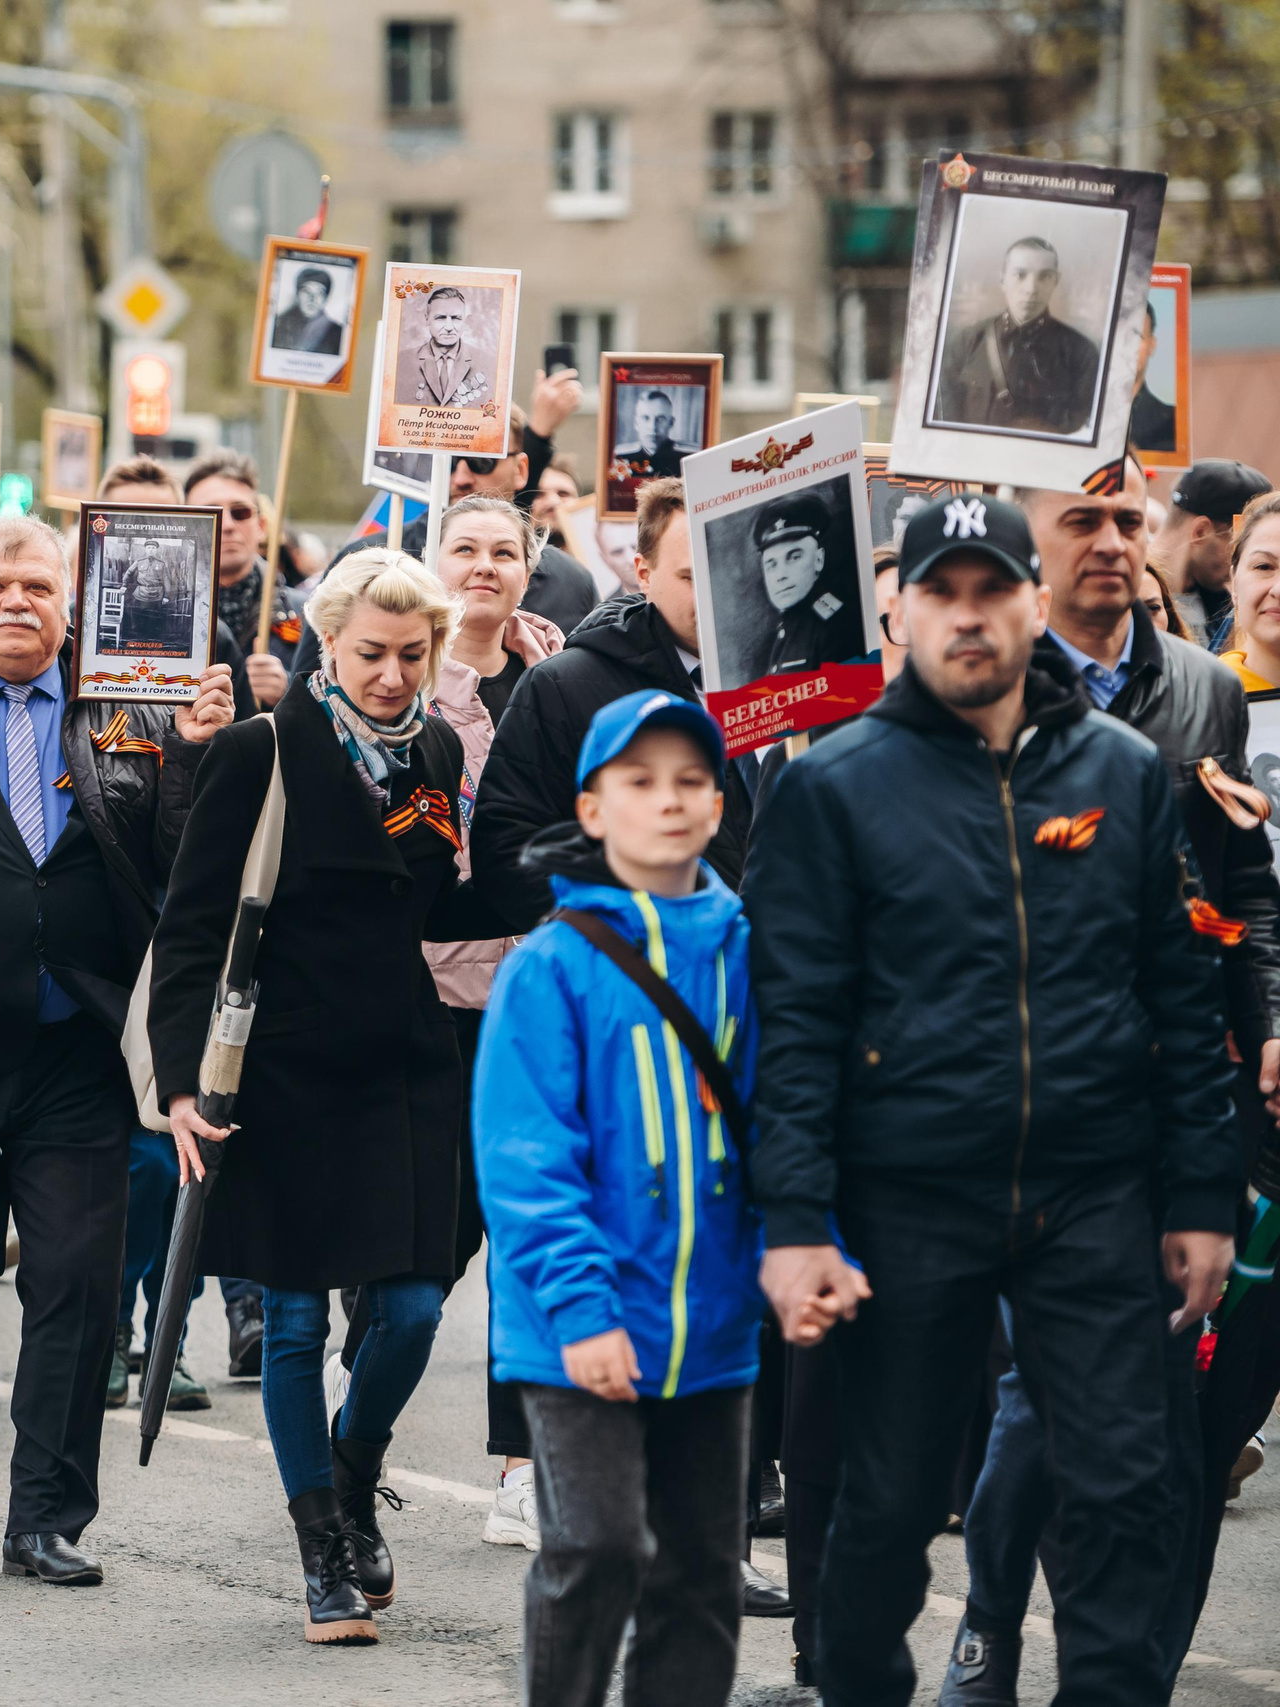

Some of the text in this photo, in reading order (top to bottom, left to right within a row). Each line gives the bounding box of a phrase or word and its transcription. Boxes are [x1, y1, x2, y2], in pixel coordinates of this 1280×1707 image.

[982, 170, 1116, 195] БЕССМЕРТНЫЙ ПОЛК
[419, 407, 461, 420] Рожко
[398, 418, 480, 432] Пётр Исидорович
[403, 430, 436, 438] 15.09.1915
[441, 433, 475, 441] 24.11.2008
[408, 439, 434, 447] Гвардии
[694, 449, 858, 514] БЕССМЕРТНЫЙ ПОЛК РОССИИ
[114, 522, 187, 533] БЕССМЕРТНЫЙ ПОЛК
[943, 498, 988, 539] NY
[101, 685, 140, 693] ПОМНЮ!
[149, 687, 192, 695] ГОРЖУСЬ!
[722, 676, 829, 728] БЕРЕСНЕВ
[725, 710, 785, 739] АЛЕКСАНДР
[726, 718, 795, 750] НИКОЛАЕВИЧ
